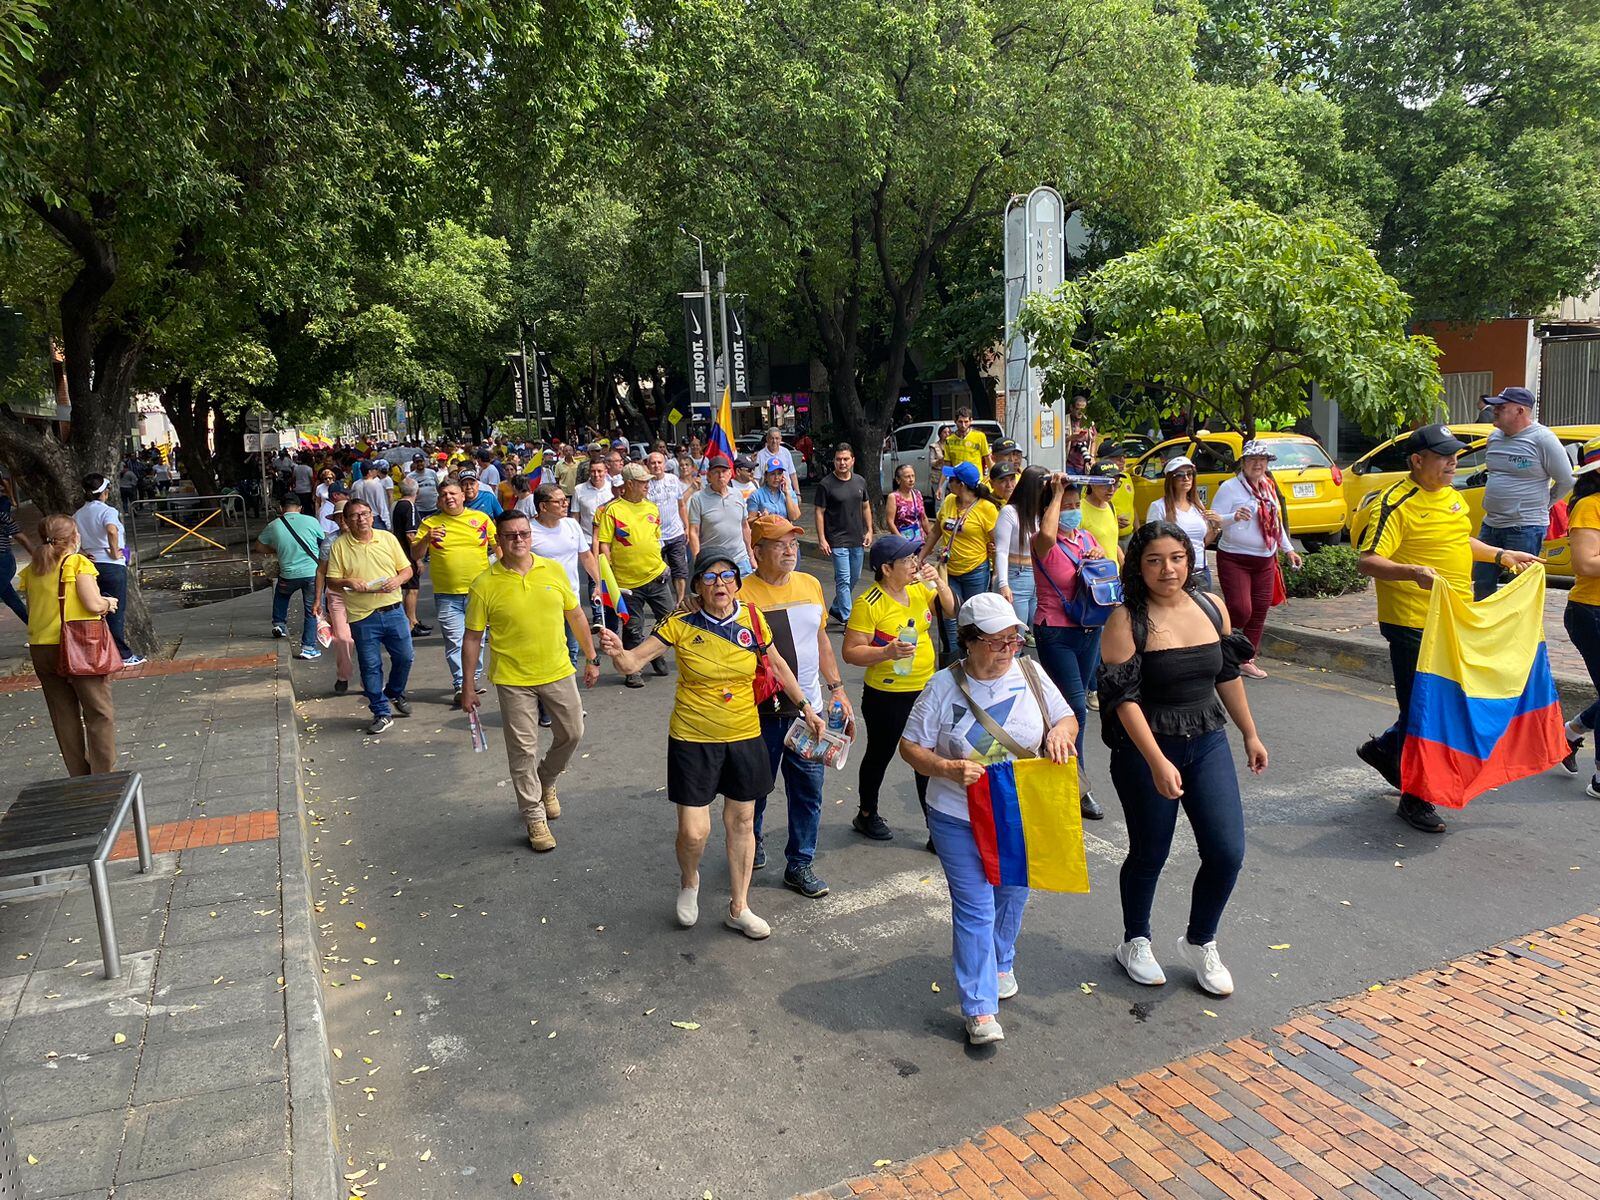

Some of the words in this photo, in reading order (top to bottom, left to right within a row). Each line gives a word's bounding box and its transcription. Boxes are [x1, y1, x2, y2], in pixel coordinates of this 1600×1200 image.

[692, 339, 703, 351] IT.
[733, 340, 743, 352] IT.
[693, 353, 704, 368] DO
[734, 353, 744, 368] DO
[695, 370, 705, 393] JUST
[735, 370, 746, 393] JUST
[515, 389, 522, 398] DO
[542, 388, 550, 397] DO
[515, 399, 523, 413] JUST
[543, 398, 551, 412] JUST
